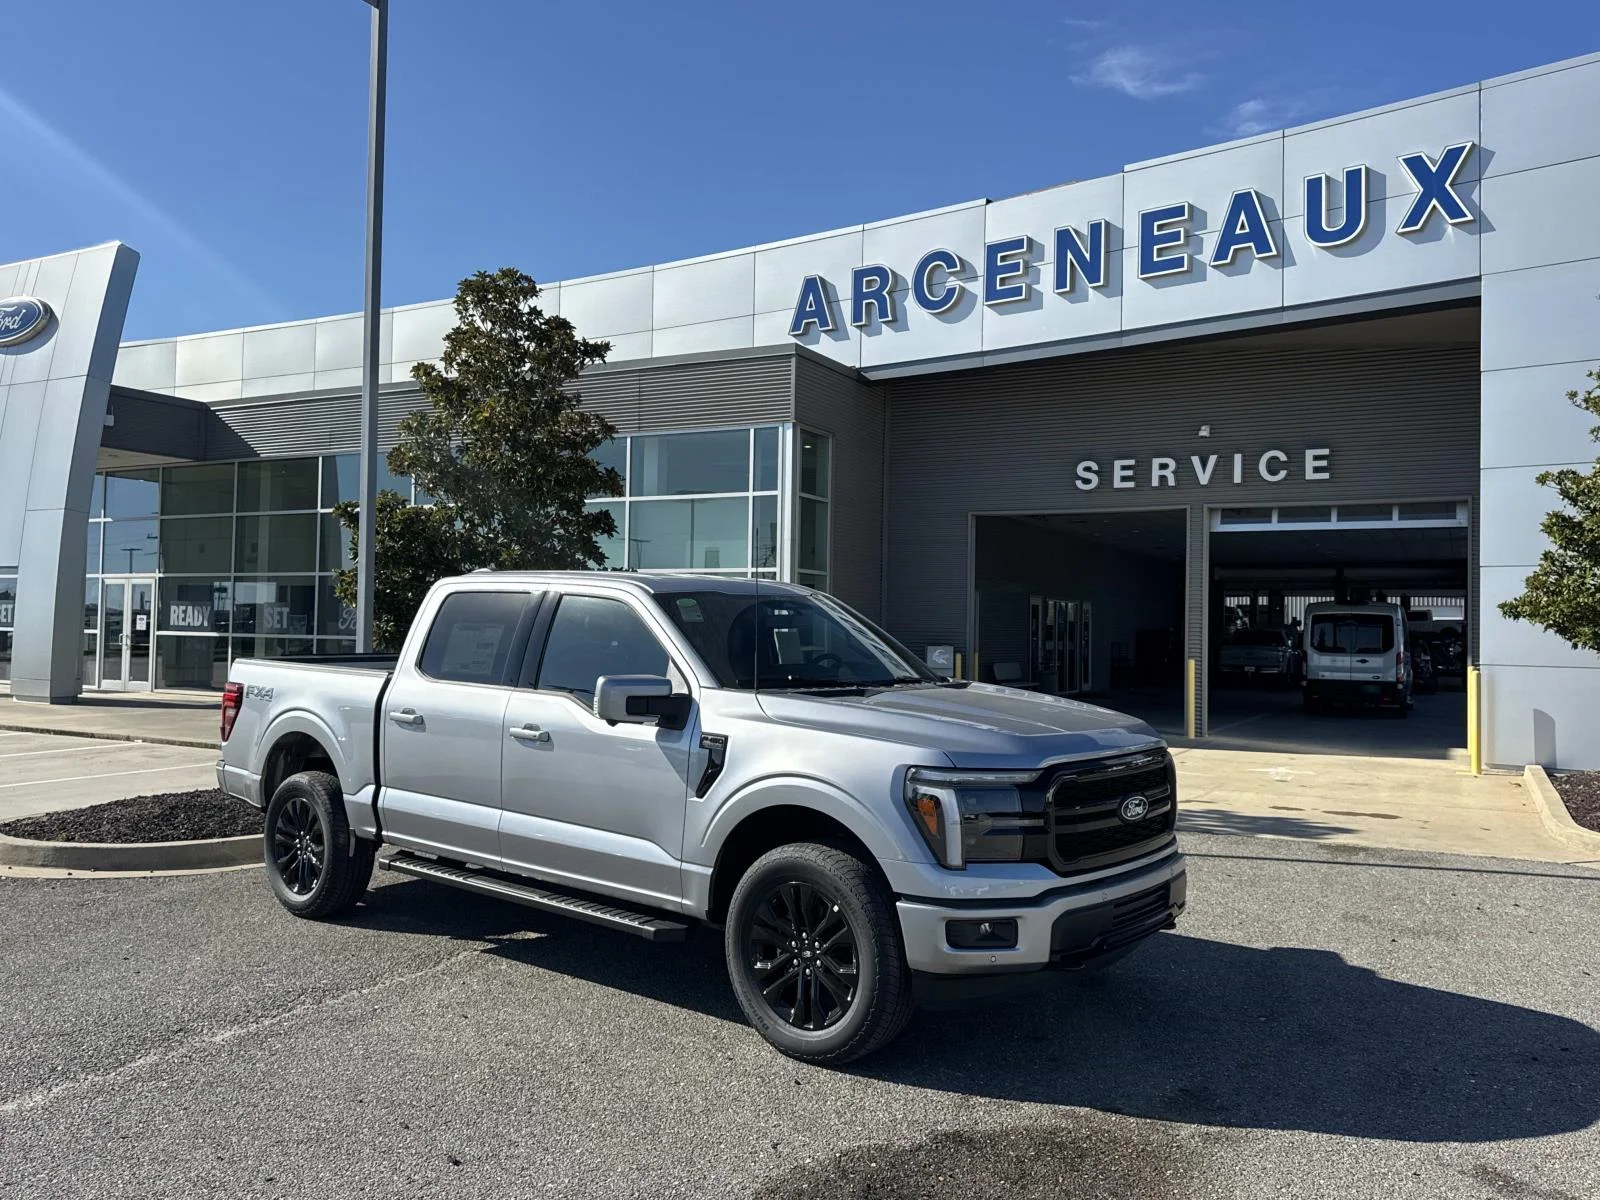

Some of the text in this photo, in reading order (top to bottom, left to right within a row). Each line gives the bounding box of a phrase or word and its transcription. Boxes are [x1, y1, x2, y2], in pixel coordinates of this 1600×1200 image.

[788, 140, 1474, 336] ARCENEAUX
[1075, 448, 1330, 490] SERVICE
[0, 603, 13, 623] ET
[169, 605, 212, 627] READY
[263, 607, 290, 629] SET
[245, 685, 275, 701] FX4
